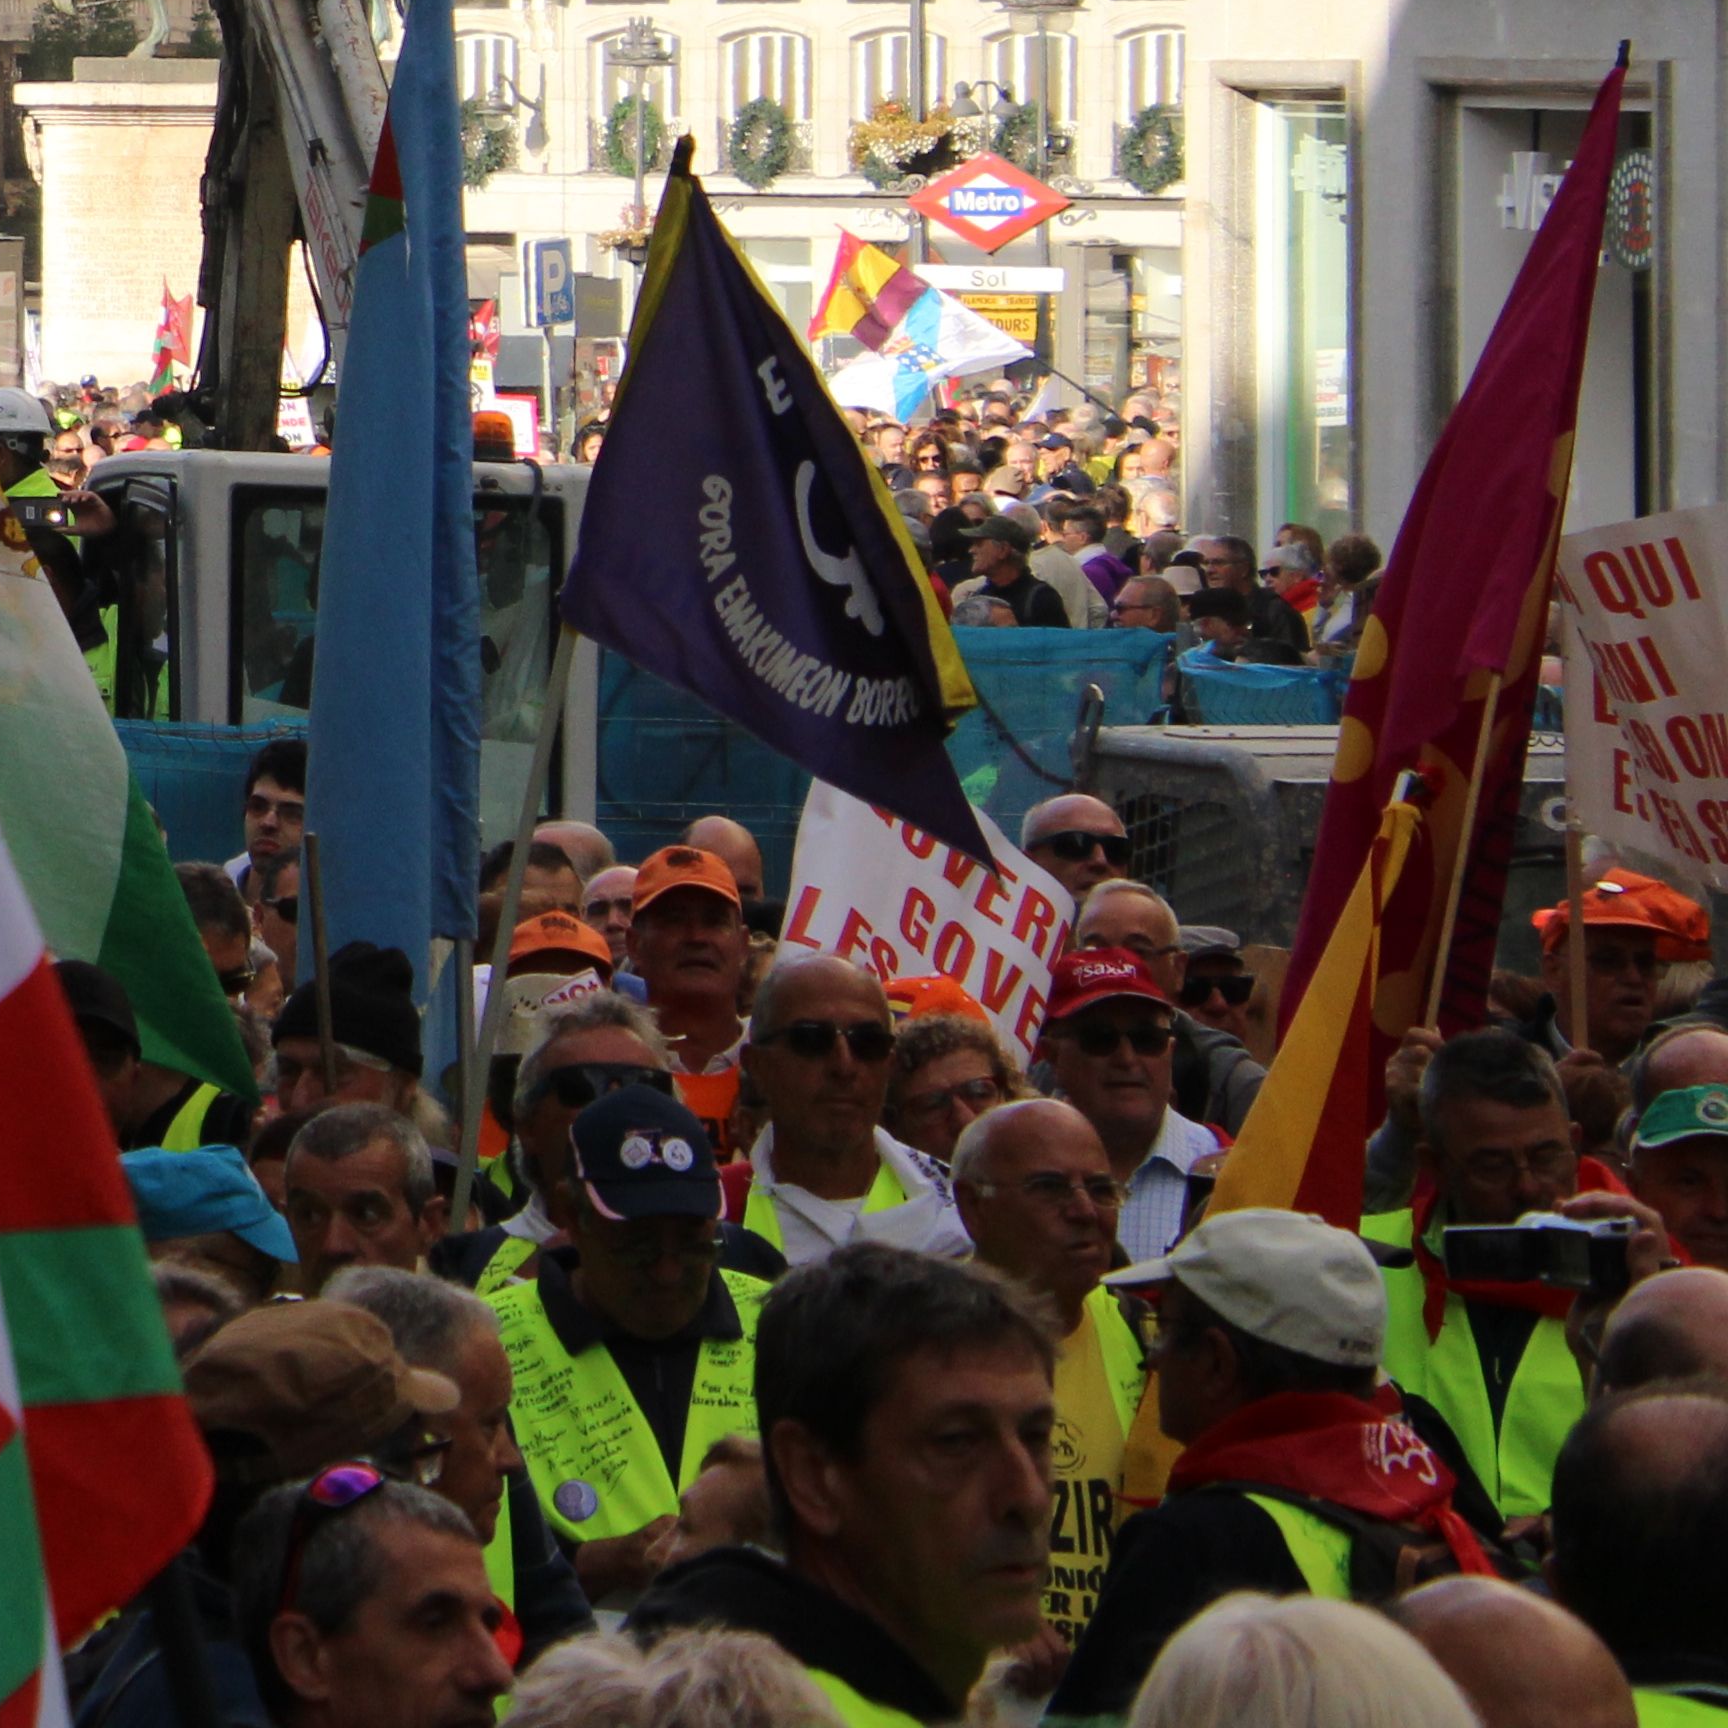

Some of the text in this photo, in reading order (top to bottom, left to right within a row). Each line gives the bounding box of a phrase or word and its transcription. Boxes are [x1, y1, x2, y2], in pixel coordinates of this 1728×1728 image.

[954, 191, 1020, 212] Metro
[971, 270, 1007, 287] Sol
[1584, 537, 1702, 620] QUI
